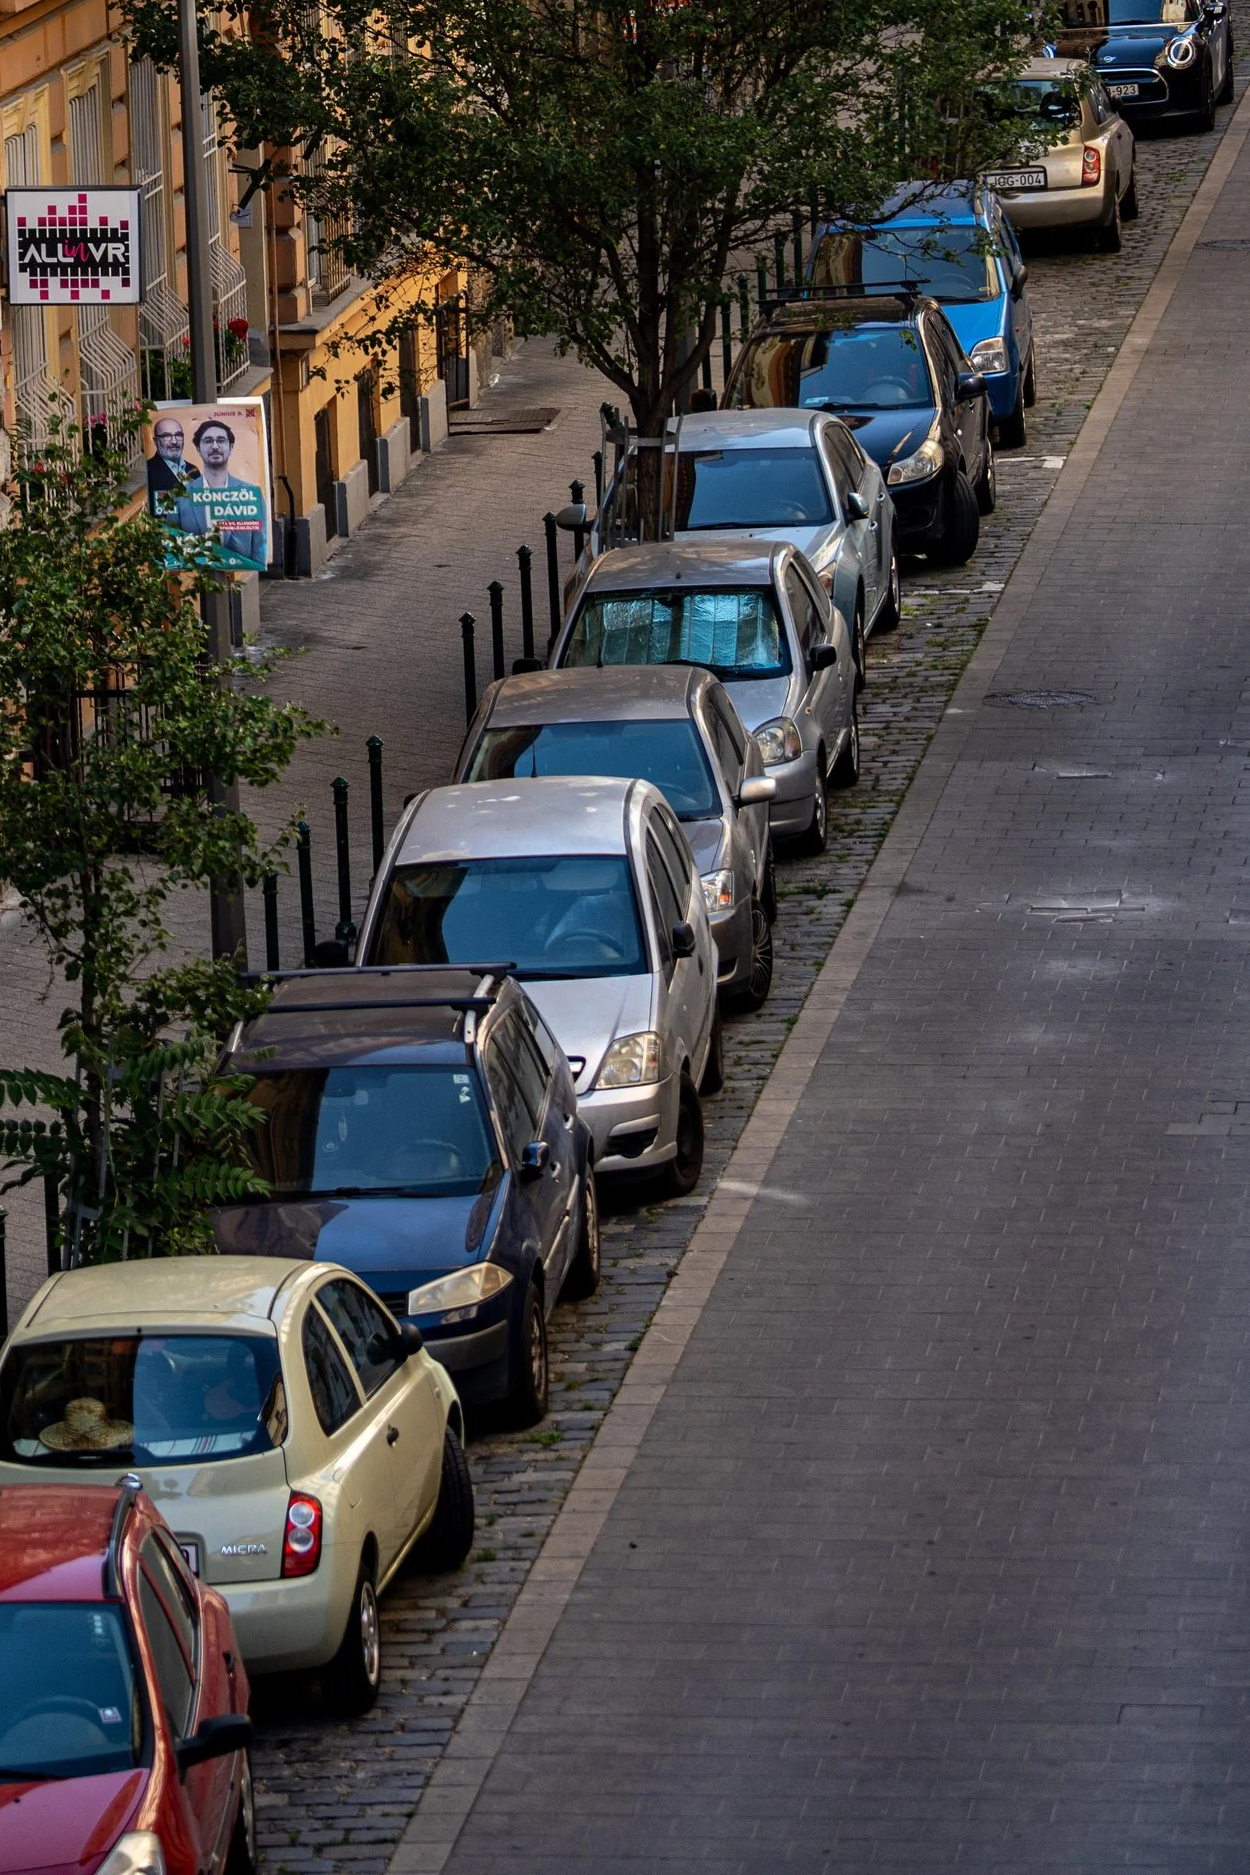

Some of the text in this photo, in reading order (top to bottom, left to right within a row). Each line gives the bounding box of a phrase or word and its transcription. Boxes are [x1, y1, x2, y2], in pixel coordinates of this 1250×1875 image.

[23, 243, 75, 264] ALL
[87, 242, 126, 263] VR
[193, 488, 258, 503] KÖNCZÖL
[213, 502, 258, 516] DÁVID
[221, 1544, 267, 1556] MICRA
